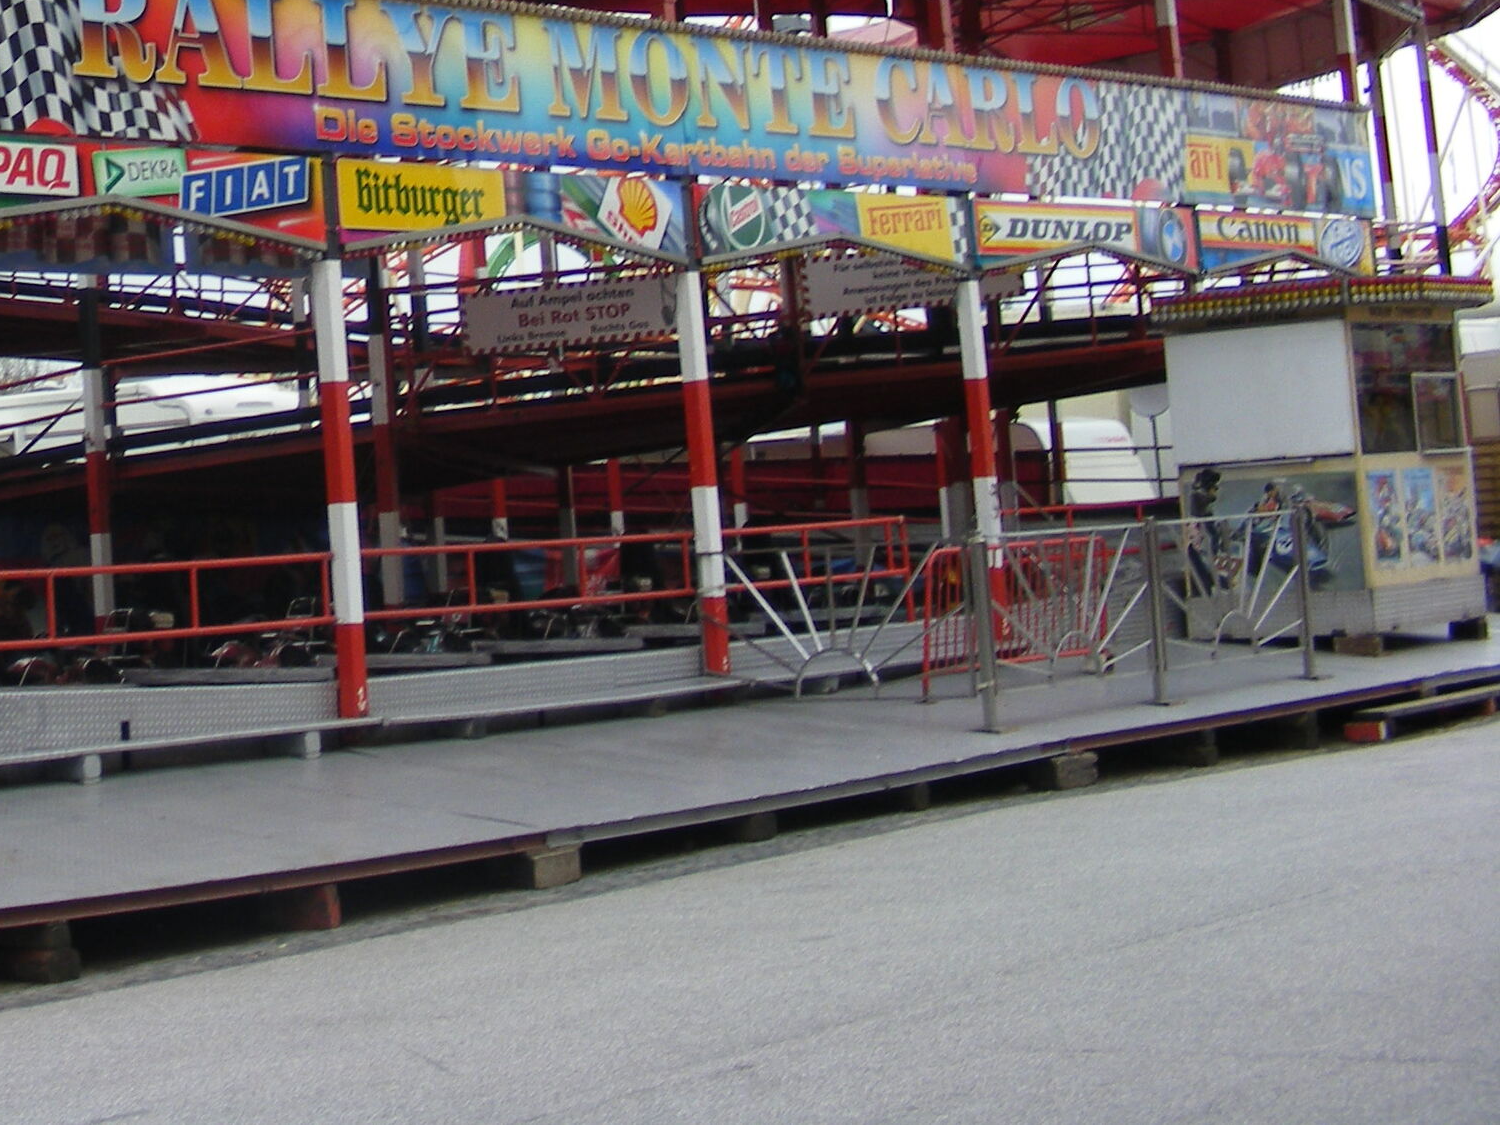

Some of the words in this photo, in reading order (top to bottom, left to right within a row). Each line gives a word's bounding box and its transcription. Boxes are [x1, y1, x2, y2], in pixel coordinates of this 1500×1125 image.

[544, 17, 857, 140] MONTE
[876, 53, 1101, 160] CARLO
[314, 106, 378, 144] Die
[390, 112, 576, 160] Stockwerk
[586, 128, 778, 173] Go-Kartbahn
[784, 143, 830, 174] der
[838, 145, 978, 184] Superlative
[127, 158, 180, 182] DEKRA
[189, 164, 300, 213] FIAT
[355, 167, 485, 226] Bitburger
[868, 204, 944, 237] Ferrari
[1006, 216, 1133, 243] DUNLOP
[1217, 216, 1299, 244] Canon
[539, 291, 582, 307] Ampel
[518, 312, 546, 327] Bei
[551, 309, 580, 324] Rot
[586, 303, 632, 321] STOP
